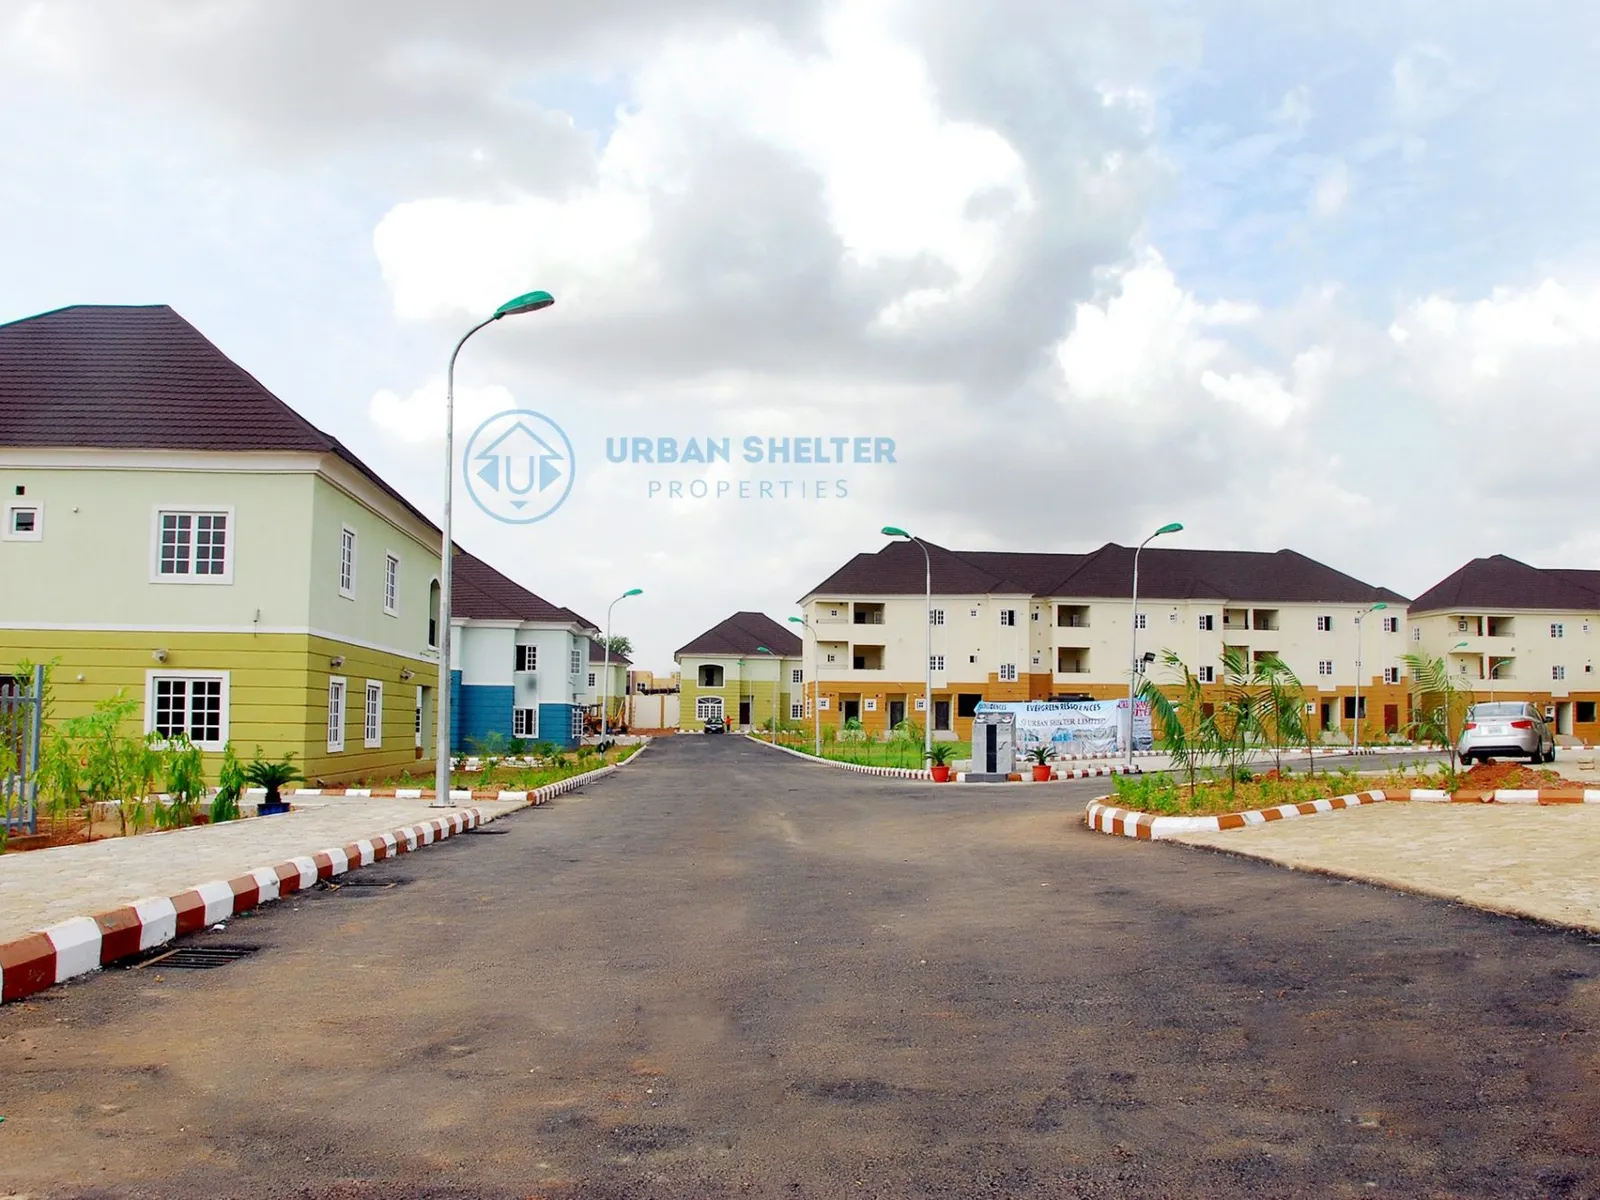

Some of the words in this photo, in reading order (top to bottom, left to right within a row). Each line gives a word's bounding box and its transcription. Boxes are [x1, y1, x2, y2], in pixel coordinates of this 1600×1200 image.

[1026, 703, 1059, 712] EVERGREEN
[1027, 719, 1048, 727] URBAN
[1049, 718, 1076, 727] SHELTER
